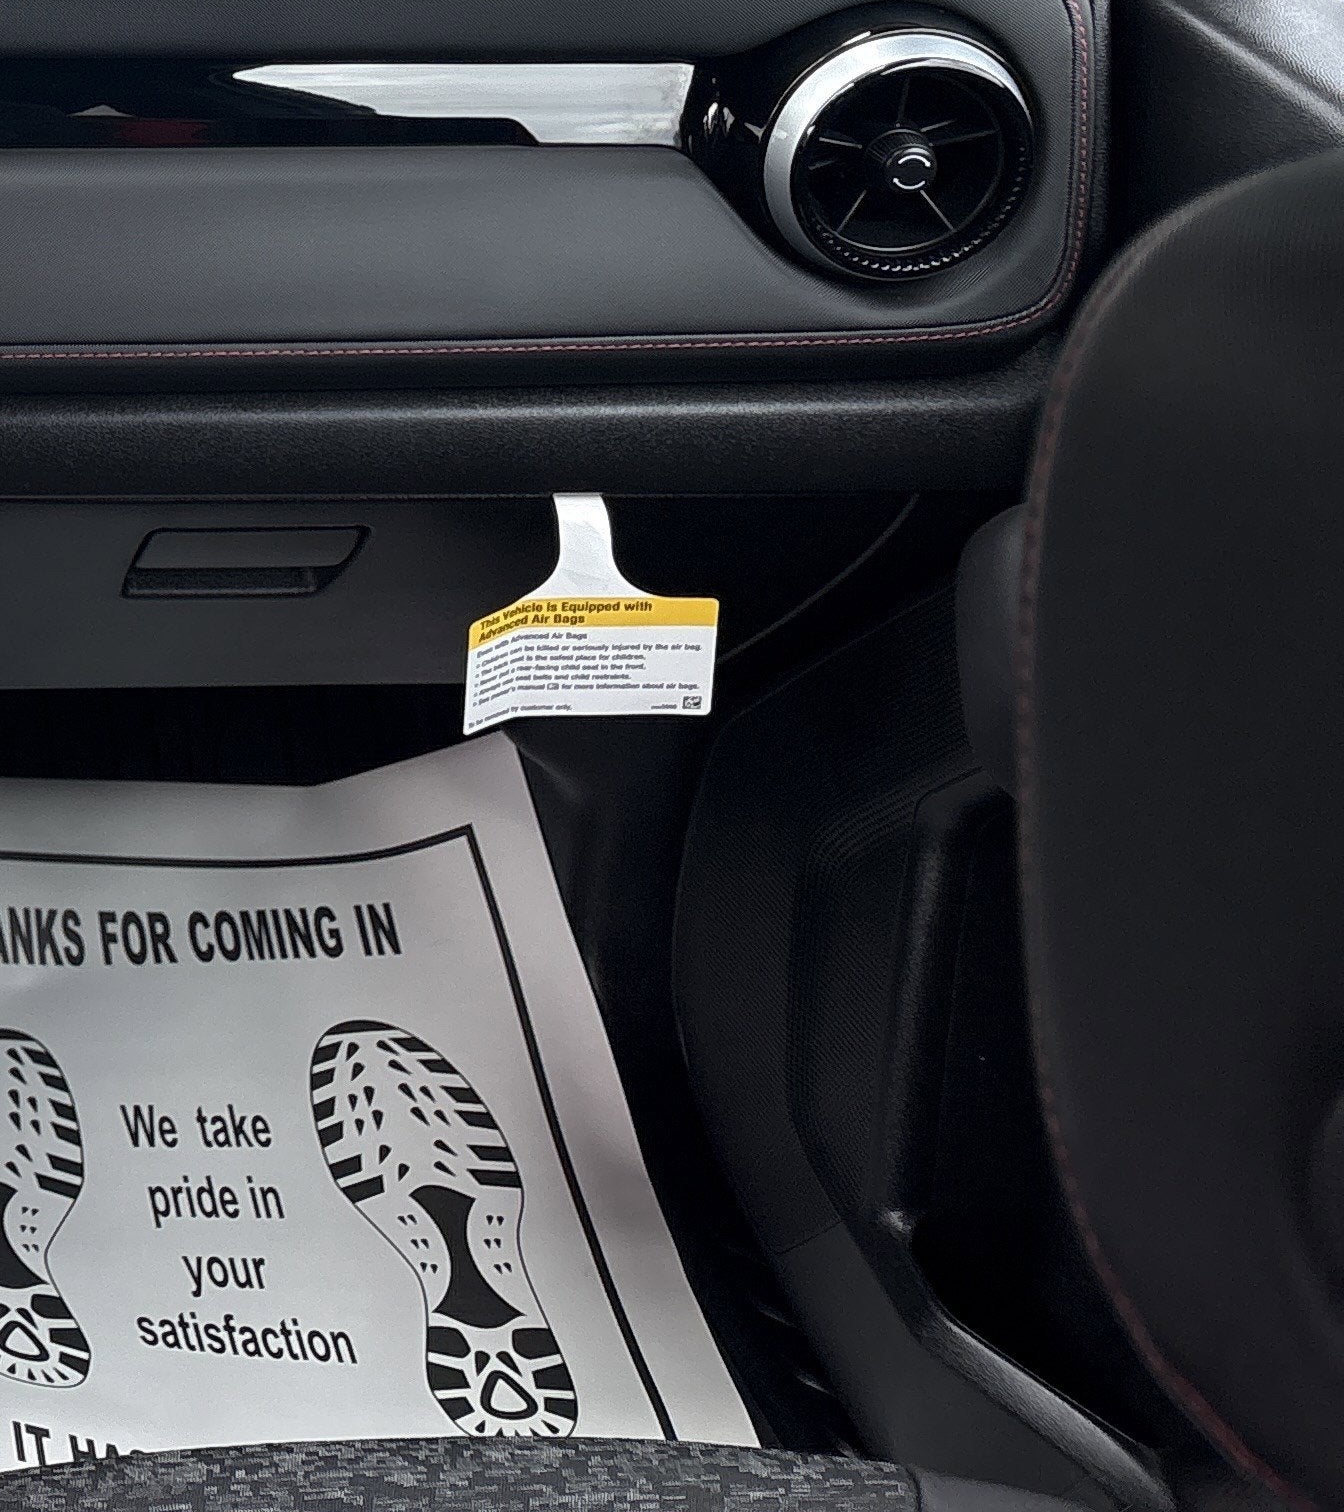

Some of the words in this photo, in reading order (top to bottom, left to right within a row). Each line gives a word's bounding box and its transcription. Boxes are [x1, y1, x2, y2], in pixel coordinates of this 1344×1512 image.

[479, 616, 528, 642] Advanced
[532, 614, 549, 623] Air
[554, 614, 585, 625] Bags
[480, 615, 500, 630] This
[503, 602, 543, 620] Vehicle
[547, 602, 557, 612] is
[561, 601, 620, 614] Equipped
[624, 601, 652, 611] with
[99, 909, 177, 965] FOR
[188, 905, 343, 963] COMING
[354, 902, 402, 957] IN
[120, 1103, 179, 1150] We
[196, 1104, 272, 1149] take
[148, 1175, 240, 1229] pride
[248, 1176, 285, 1219] in
[182, 1255, 266, 1298] your
[136, 1312, 359, 1366] satisfaction
[12, 1420, 51, 1466] IT
